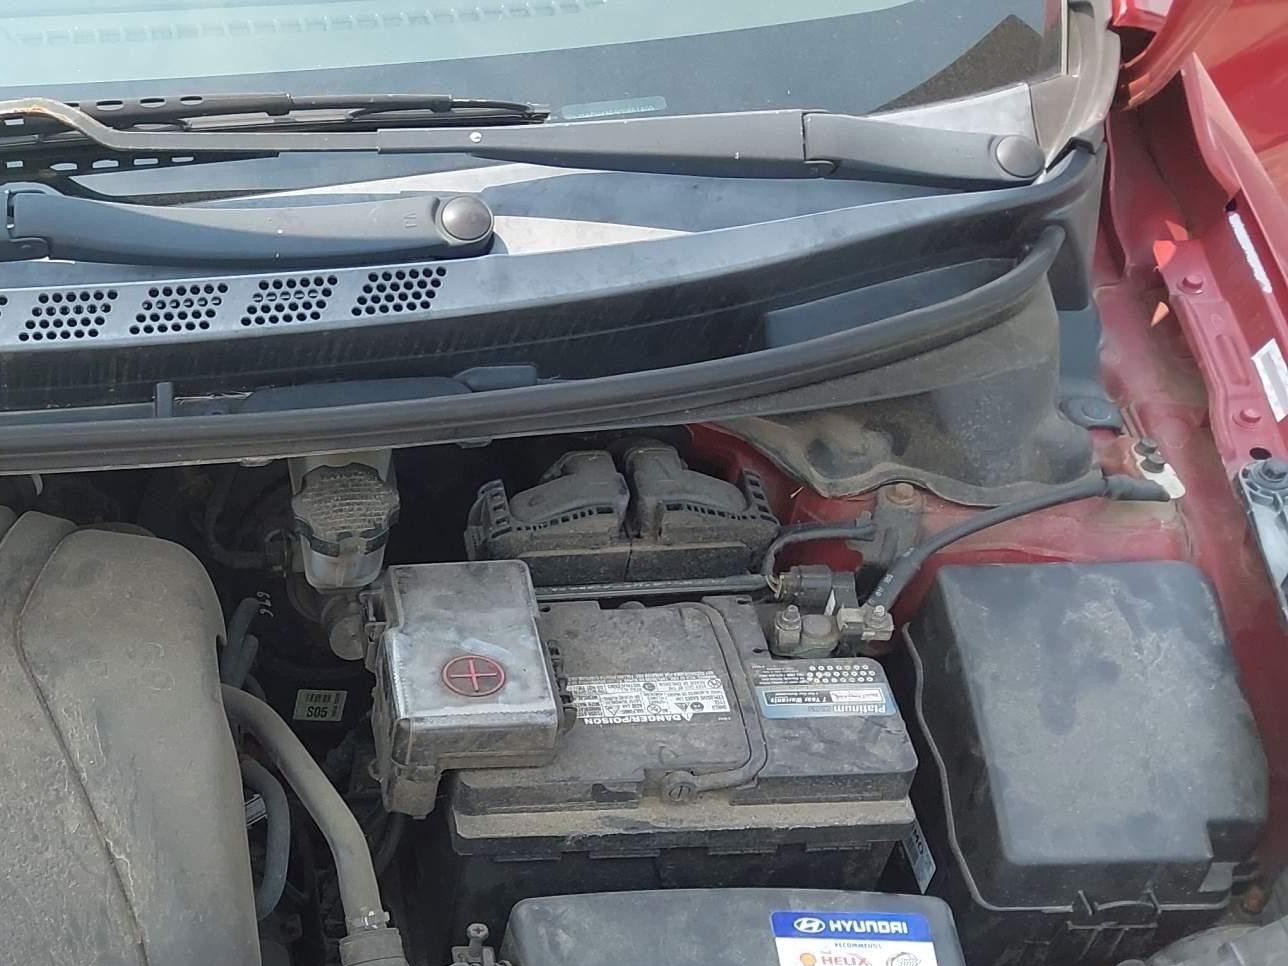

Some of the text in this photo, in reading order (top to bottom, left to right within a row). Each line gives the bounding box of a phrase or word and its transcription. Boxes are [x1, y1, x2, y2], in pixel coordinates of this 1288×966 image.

[833, 704, 886, 713] Platinum
[584, 714, 682, 725] DANGER/POISON
[829, 919, 909, 935] HYUNDAI
